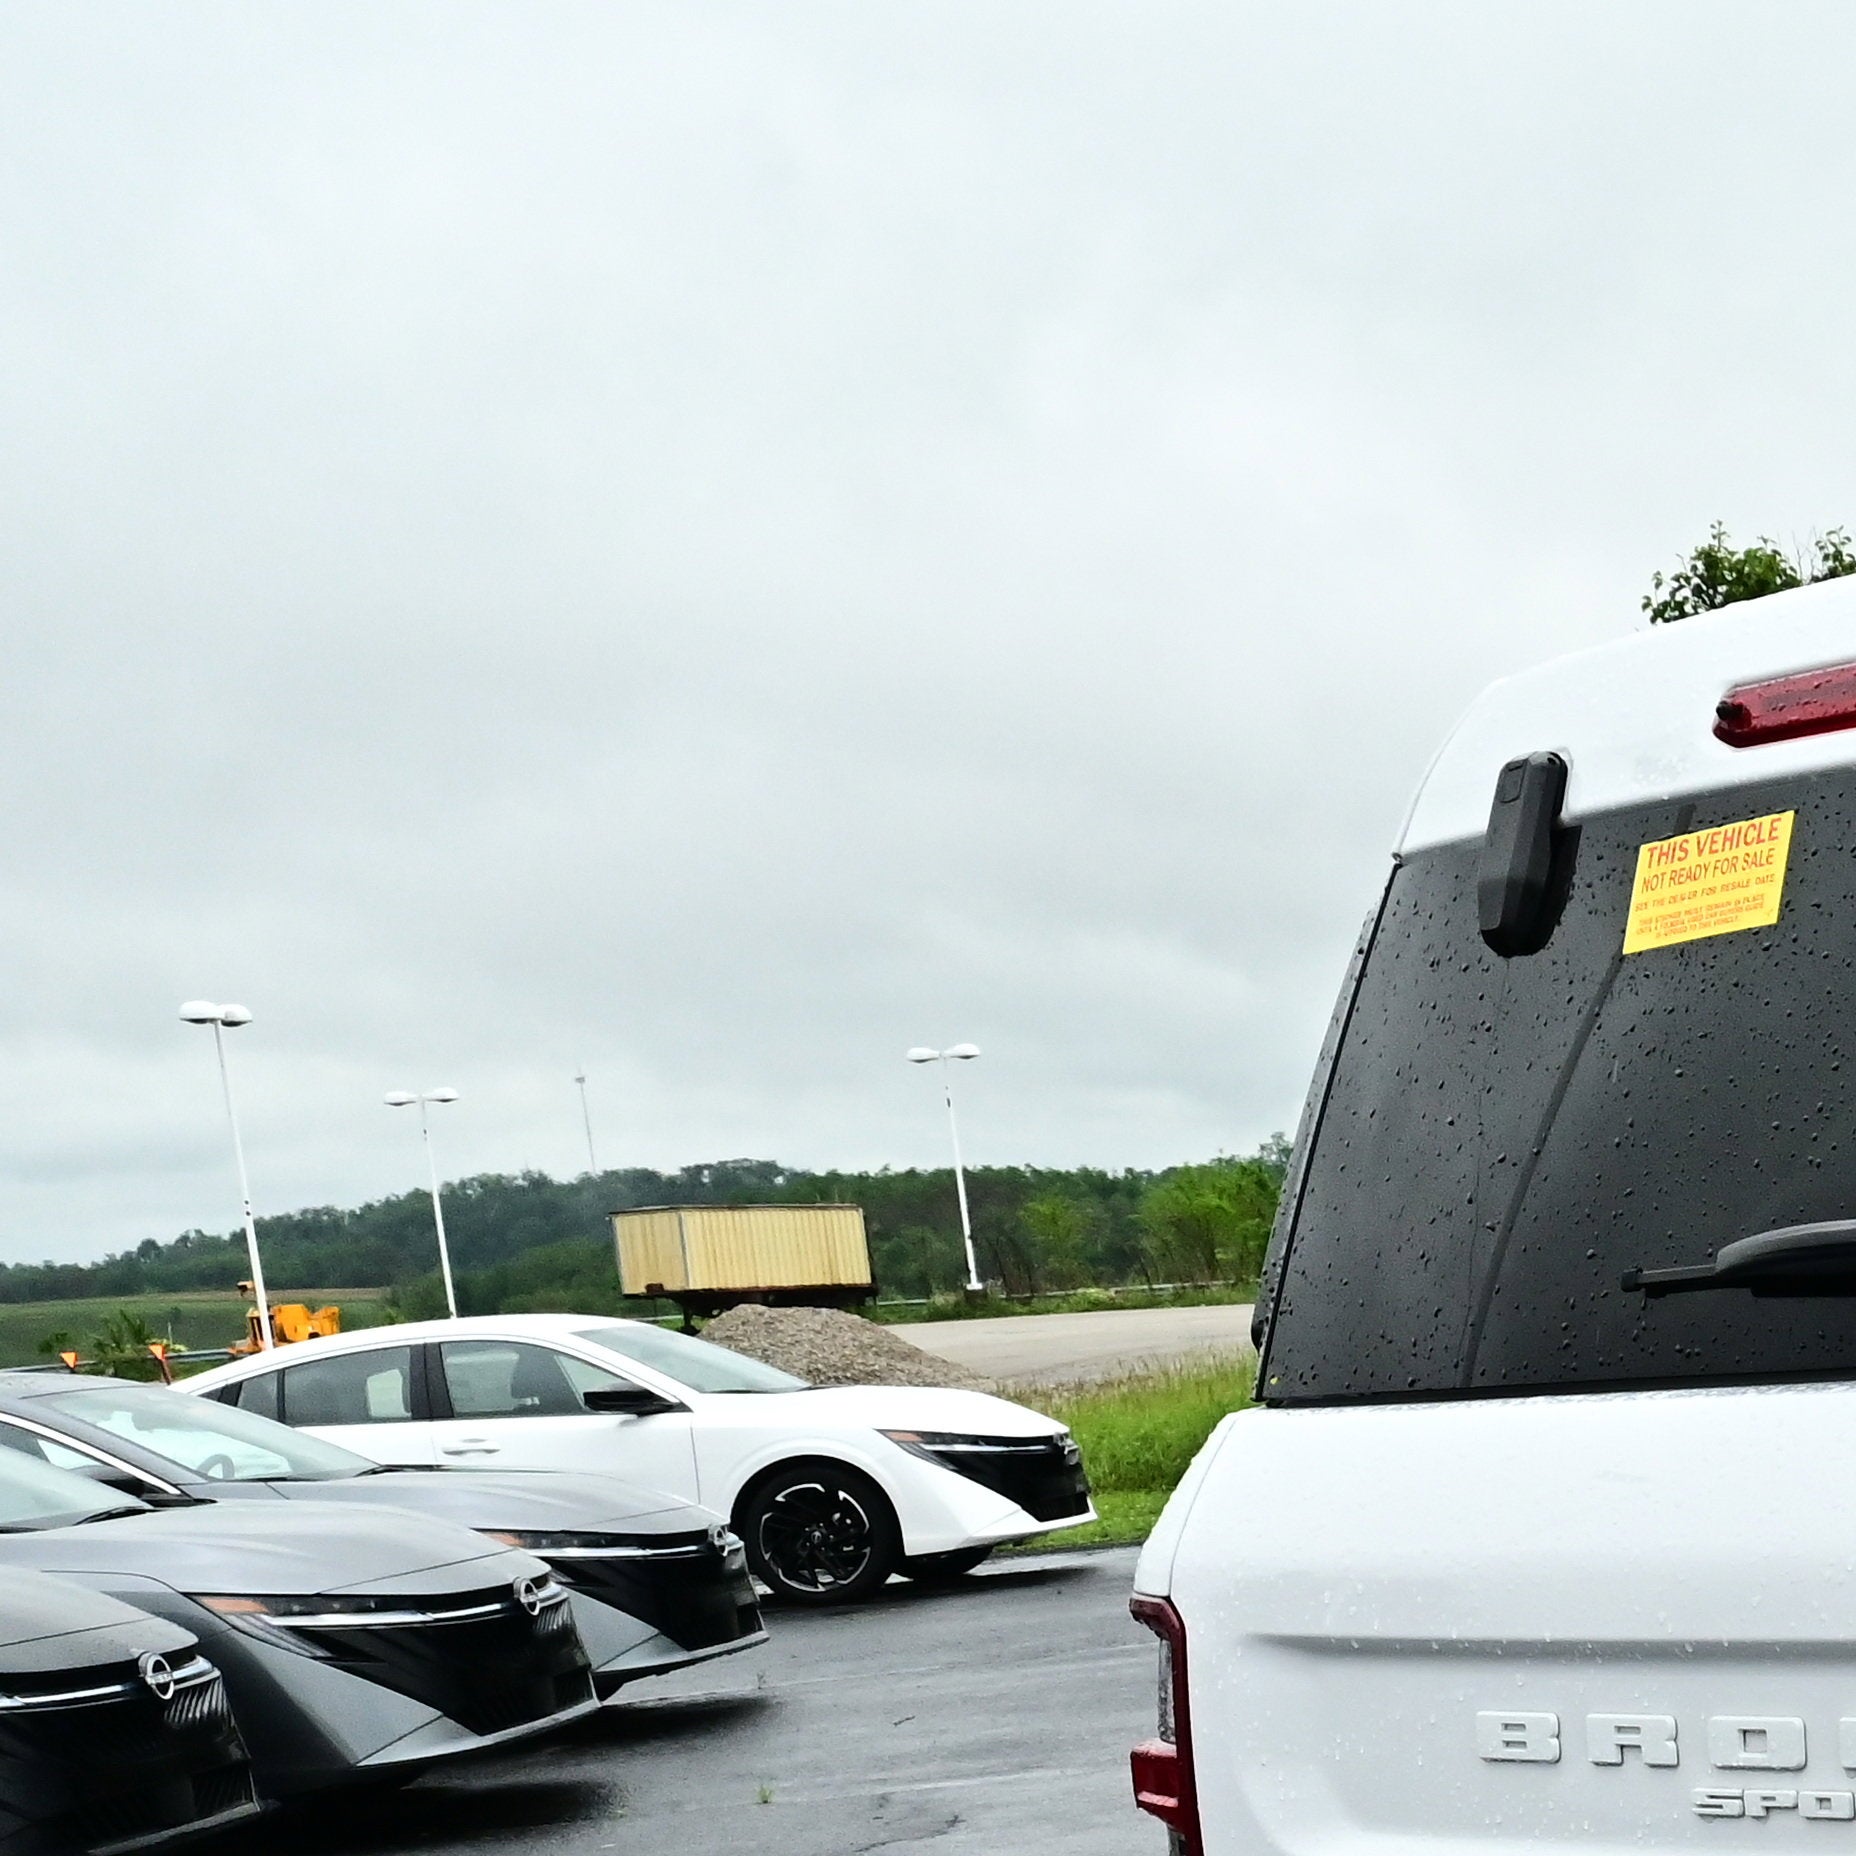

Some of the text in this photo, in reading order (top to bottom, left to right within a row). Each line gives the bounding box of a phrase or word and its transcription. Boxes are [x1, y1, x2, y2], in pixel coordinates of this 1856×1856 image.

[1647, 817, 1782, 869] THIS VEHICLE
[1641, 848, 1776, 894] NOT READY FOR SALE
[1701, 886, 1717, 898] FOR
